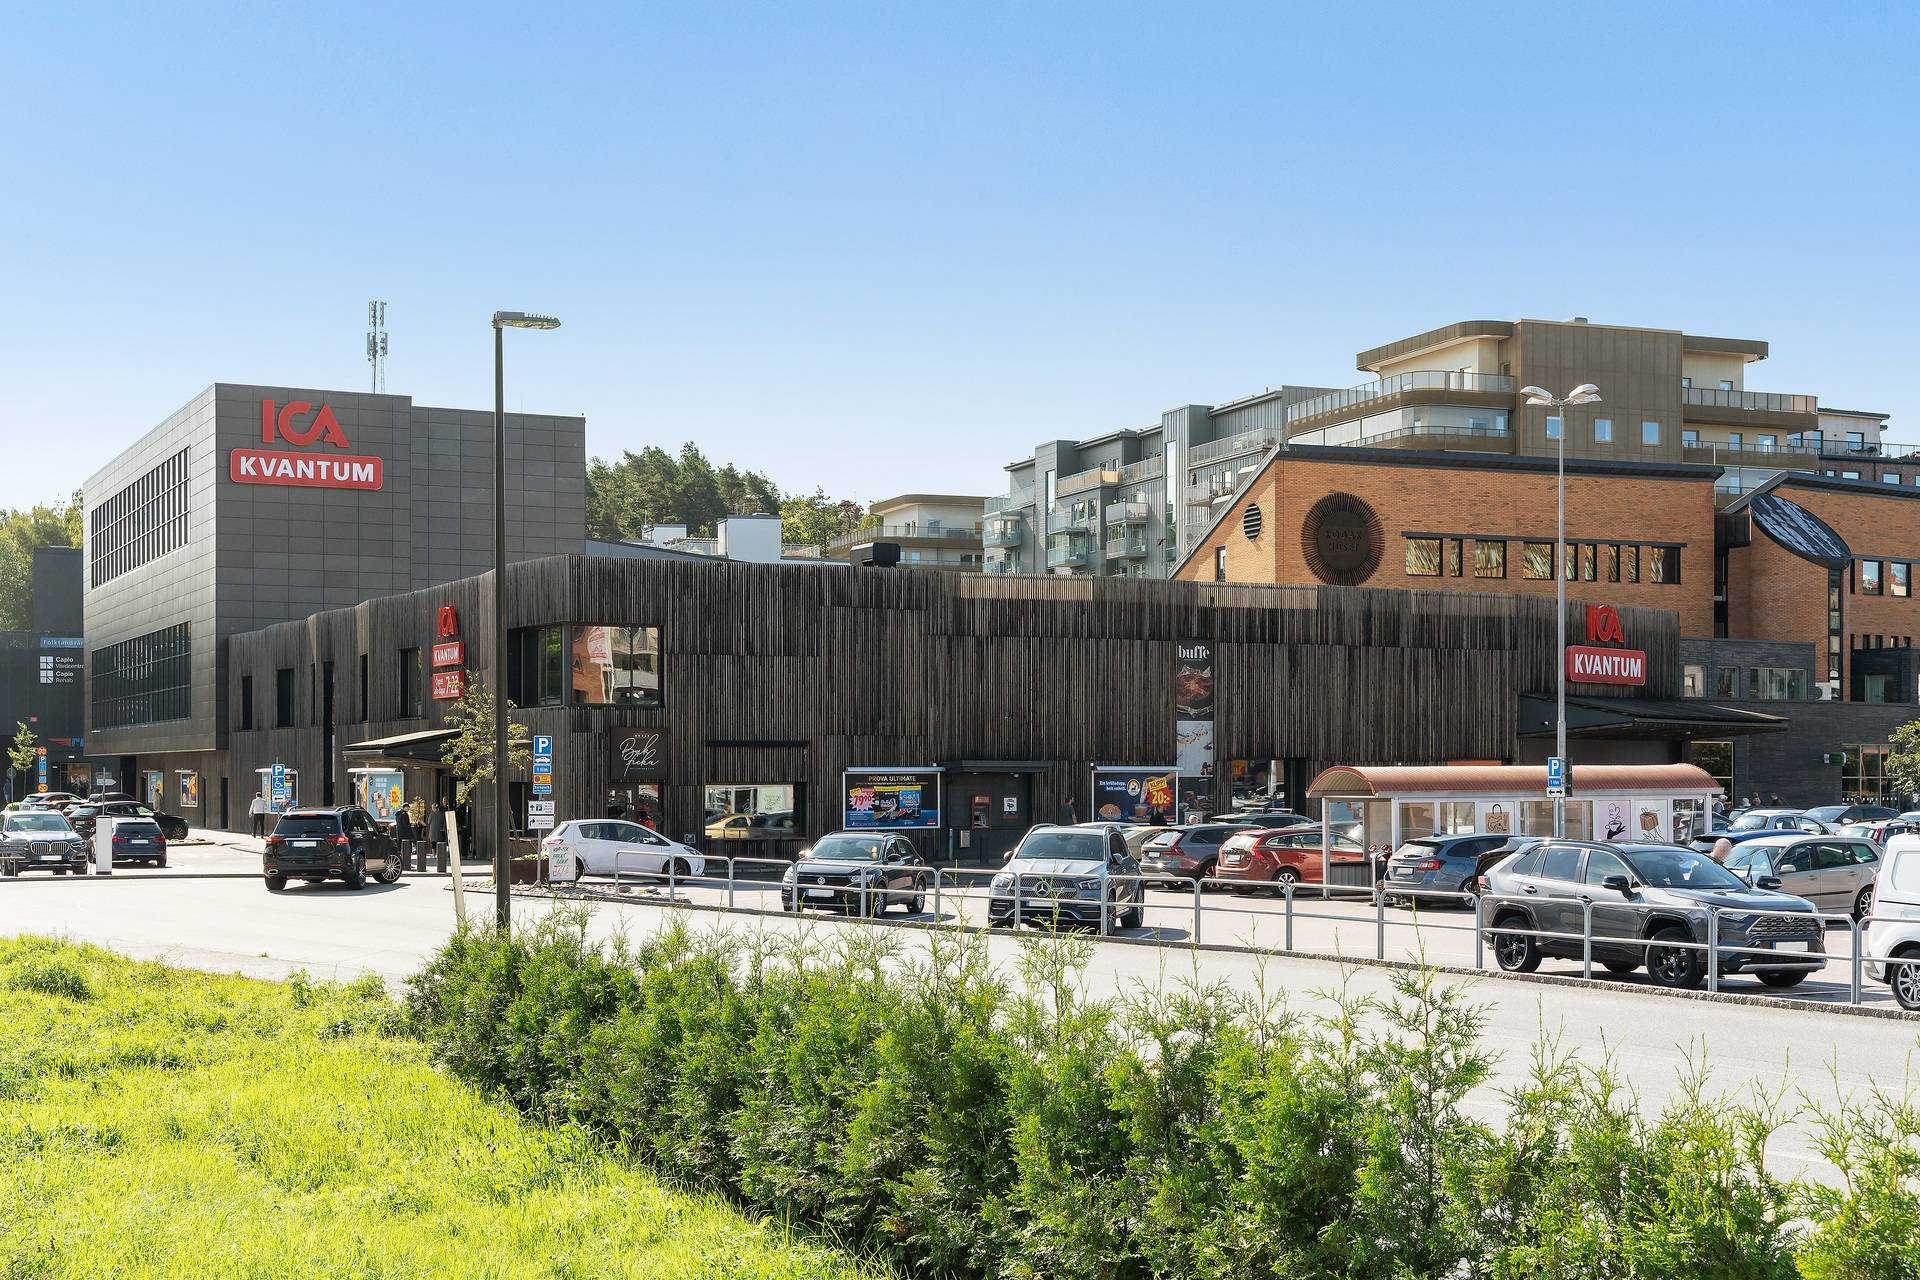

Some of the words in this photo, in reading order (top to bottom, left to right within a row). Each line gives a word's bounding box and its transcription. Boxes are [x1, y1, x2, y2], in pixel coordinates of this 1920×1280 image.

[262, 399, 350, 448] ICA
[239, 455, 374, 483] KVANTUM
[1586, 604, 1624, 642] ICA
[434, 647, 459, 661] KVANTUM
[1575, 653, 1641, 678] KVANTUM
[538, 737, 549, 753] P
[275, 765, 283, 775] P
[1551, 760, 1560, 775] P
